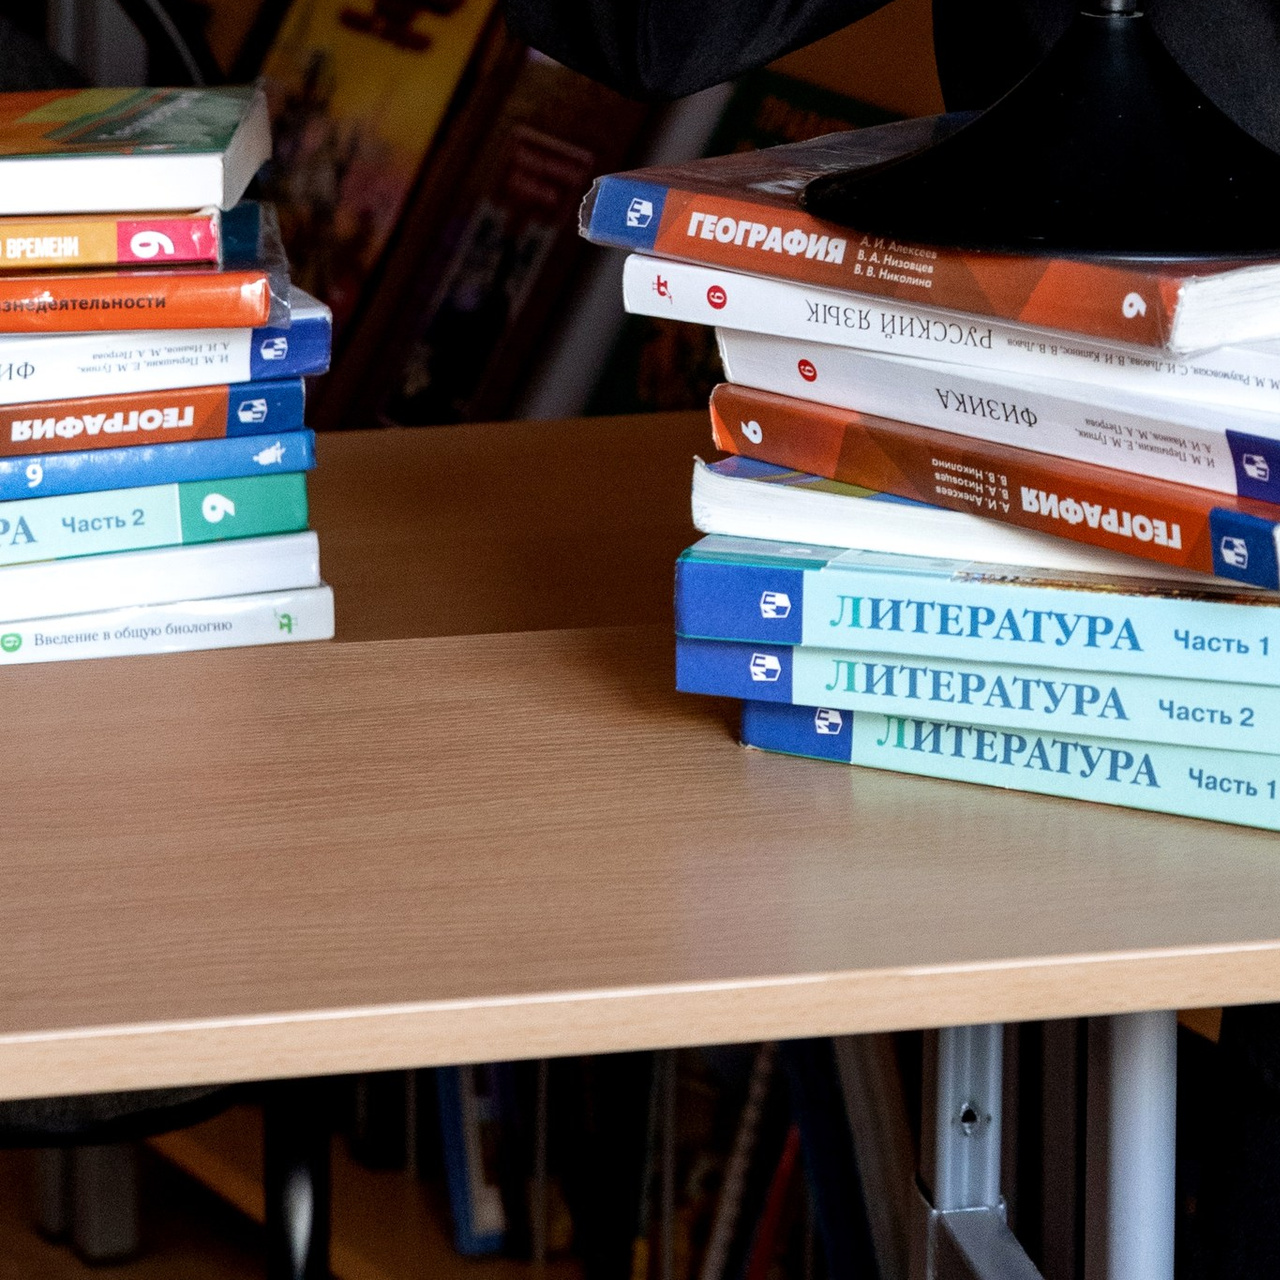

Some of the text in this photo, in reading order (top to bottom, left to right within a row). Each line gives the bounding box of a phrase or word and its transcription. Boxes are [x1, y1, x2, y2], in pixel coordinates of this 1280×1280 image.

[6, 235, 80, 259] ВРЕМЕНИ
[130, 229, 176, 260] 9
[687, 210, 848, 265] ГЕОГРАФИЯ
[874, 238, 885, 250] И.
[888, 241, 938, 260] Алексеев
[857, 249, 934, 274] В. А. Низовцев
[854, 263, 933, 289] В. В. Николина
[0, 294, 167, 314] знедеятельности
[1122, 292, 1147, 319] 9
[805, 298, 993, 351] РУССКИЙ ЯЗЫК
[935, 387, 1039, 429] ФИЗИКА
[10, 405, 195, 443] ГЕОГРАФИЯ
[740, 418, 764, 445] 9
[931, 458, 984, 481] Николина
[935, 472, 984, 495] Низовцев
[935, 485, 983, 508] Алексеев
[62, 515, 126, 534] Часть
[132, 508, 146, 527] 2
[201, 492, 236, 524] 9
[1020, 485, 1183, 550] ГЕОГРАФИЯ
[34, 619, 233, 647] Введение в общую биологию
[829, 593, 1270, 656] ЛИТЕРАТУРА Часть 1
[825, 659, 1255, 728] ЛИТЕРАТУРА Часть 2
[875, 715, 1278, 800] ЛИТЕРАТУРА Часть 1
